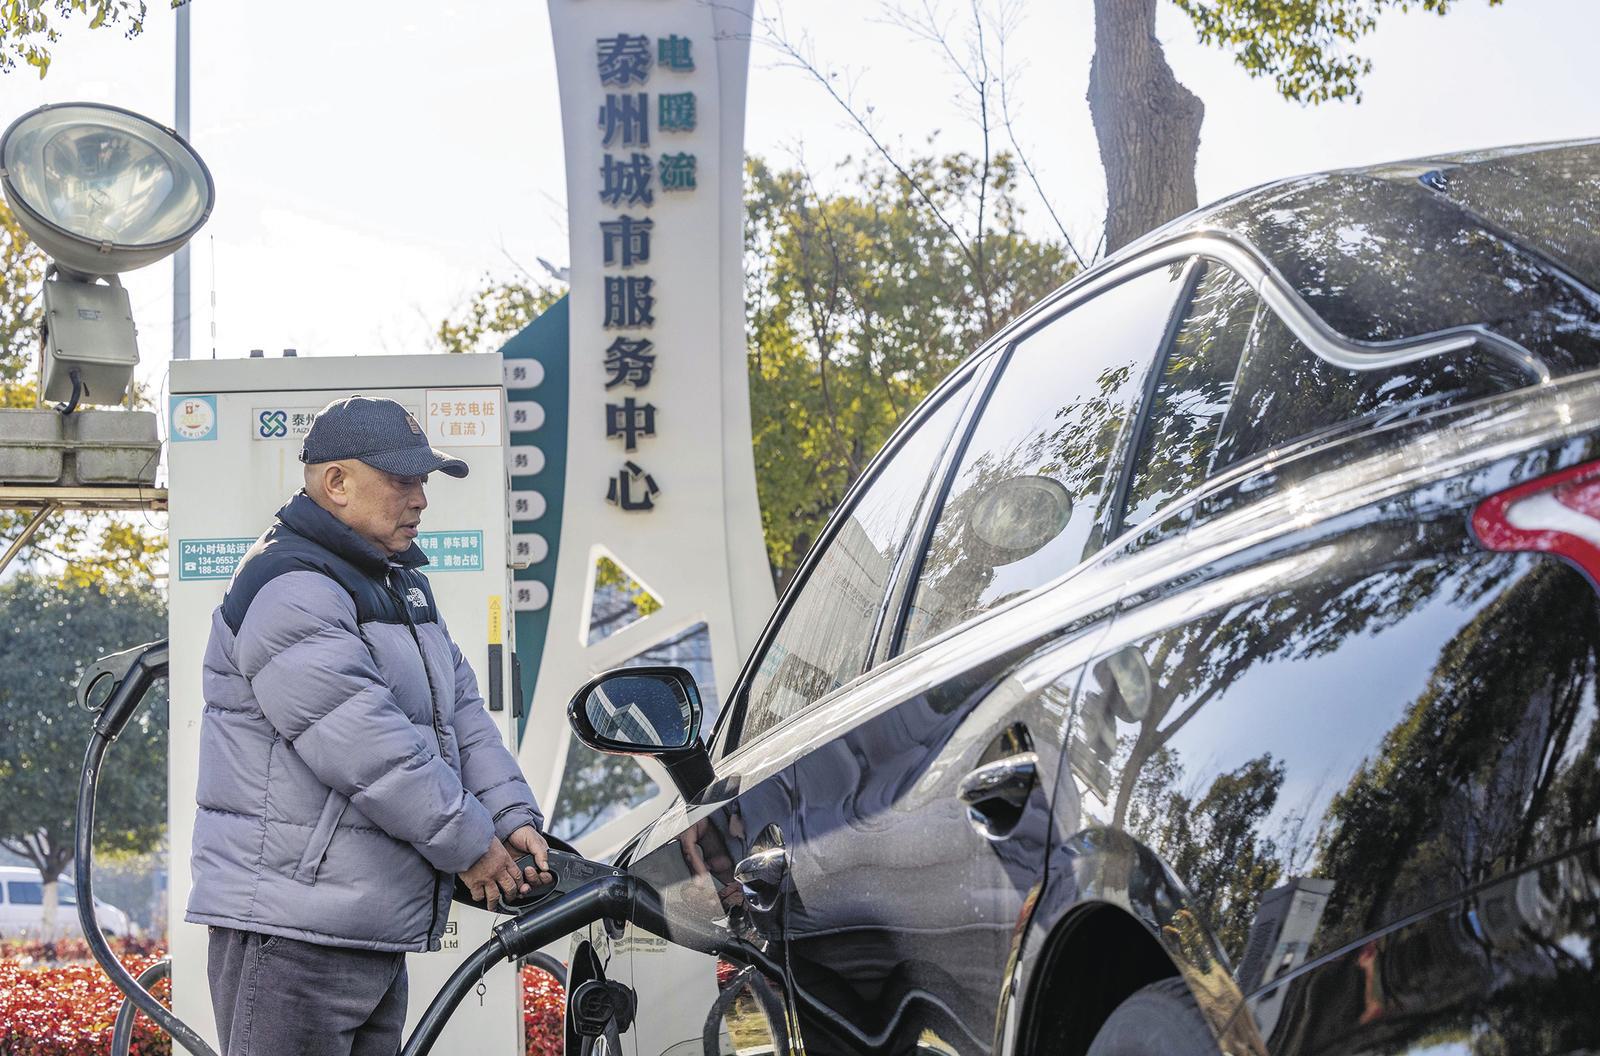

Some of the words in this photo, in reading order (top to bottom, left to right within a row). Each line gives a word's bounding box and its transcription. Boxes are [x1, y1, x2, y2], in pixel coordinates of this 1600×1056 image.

[657, 33, 697, 191] 电暖流
[597, 33, 660, 512] 泰州城市服务中心
[430, 400, 496, 417] 2号充电桩
[440, 420, 486, 438] （直流）
[428, 555, 439, 567] 走
[443, 553, 480, 567] 请勿占位
[445, 921, 458, 936] 司
[444, 939, 458, 949] Ltd
